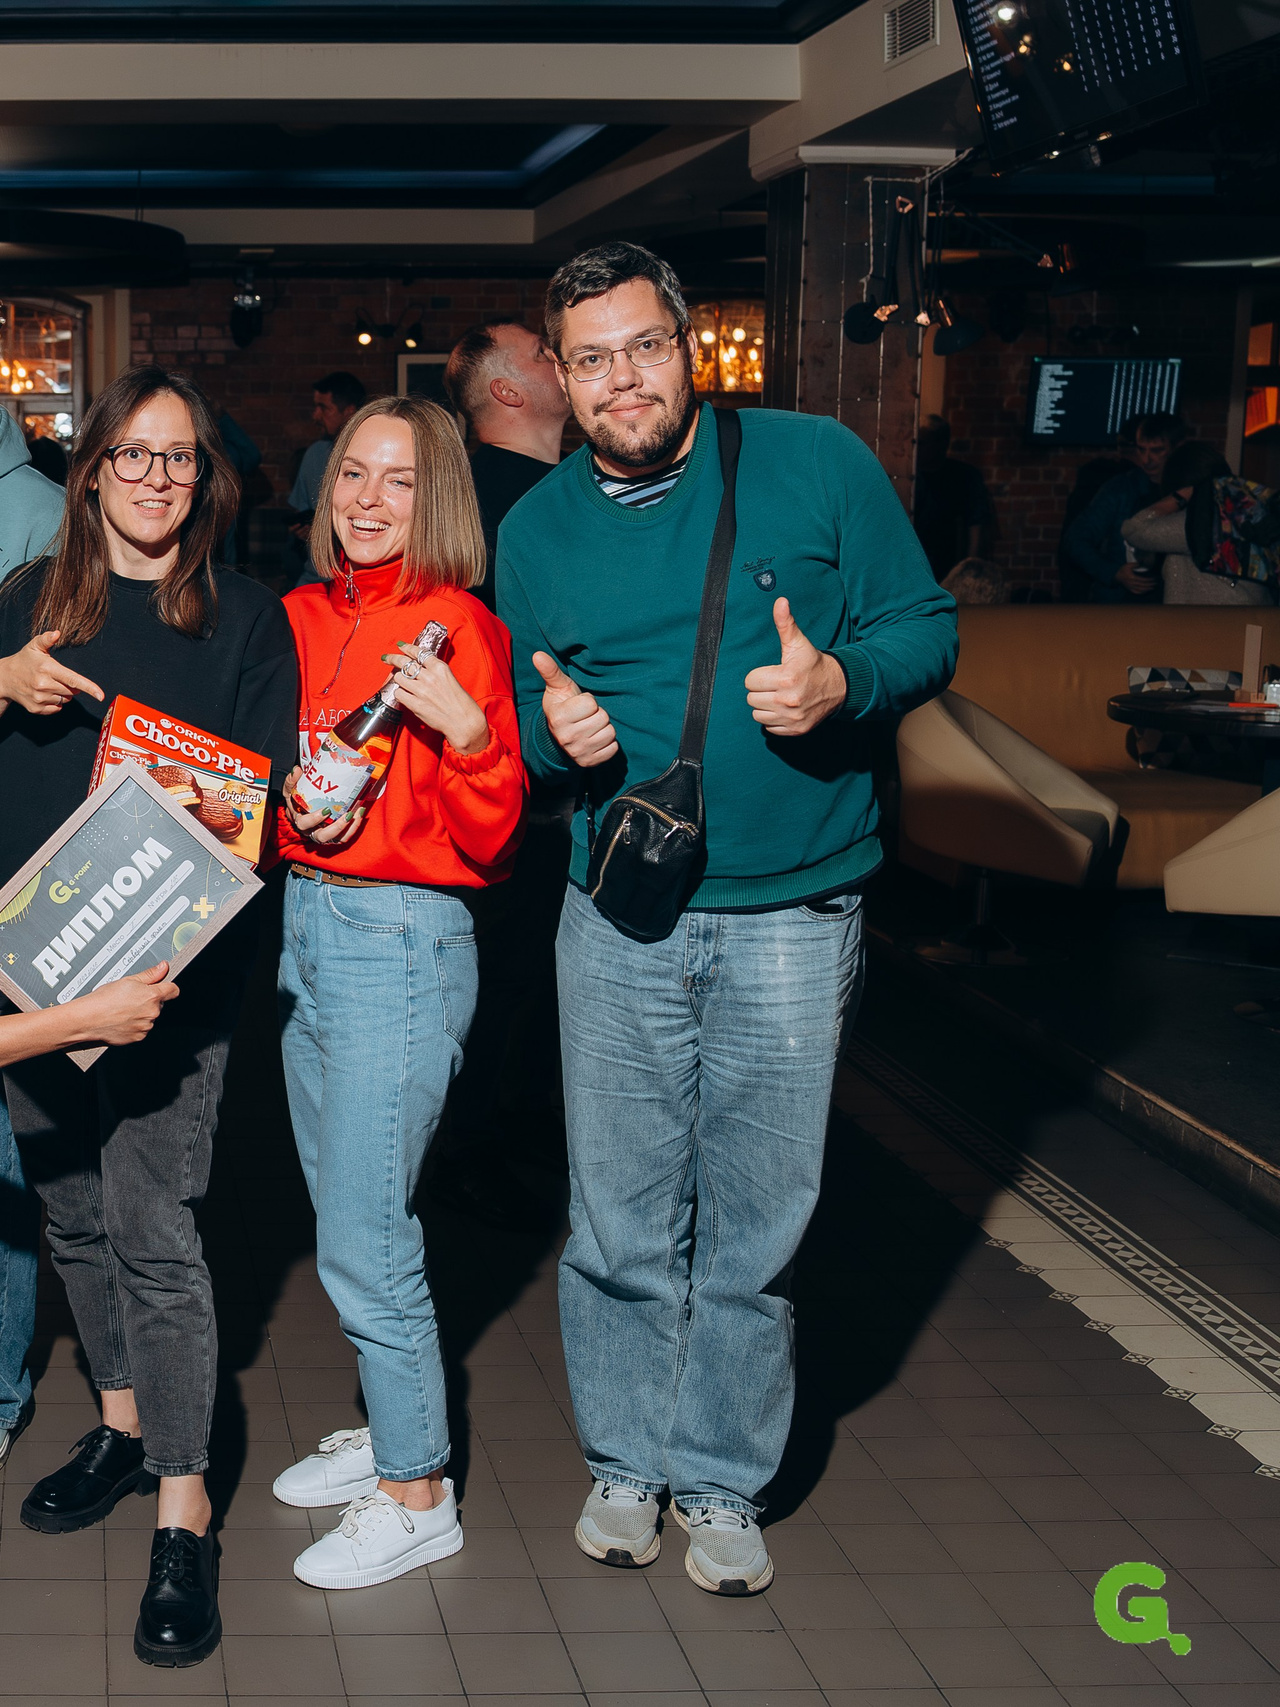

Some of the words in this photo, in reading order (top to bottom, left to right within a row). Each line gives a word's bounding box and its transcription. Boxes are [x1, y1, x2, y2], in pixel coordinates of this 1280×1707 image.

[174, 725, 217, 749] ORION
[218, 789, 261, 805] Original
[31, 836, 173, 988] ДИПЛОМ
[61, 986, 76, 1002] Дата
[106, 934, 125, 954] Место
